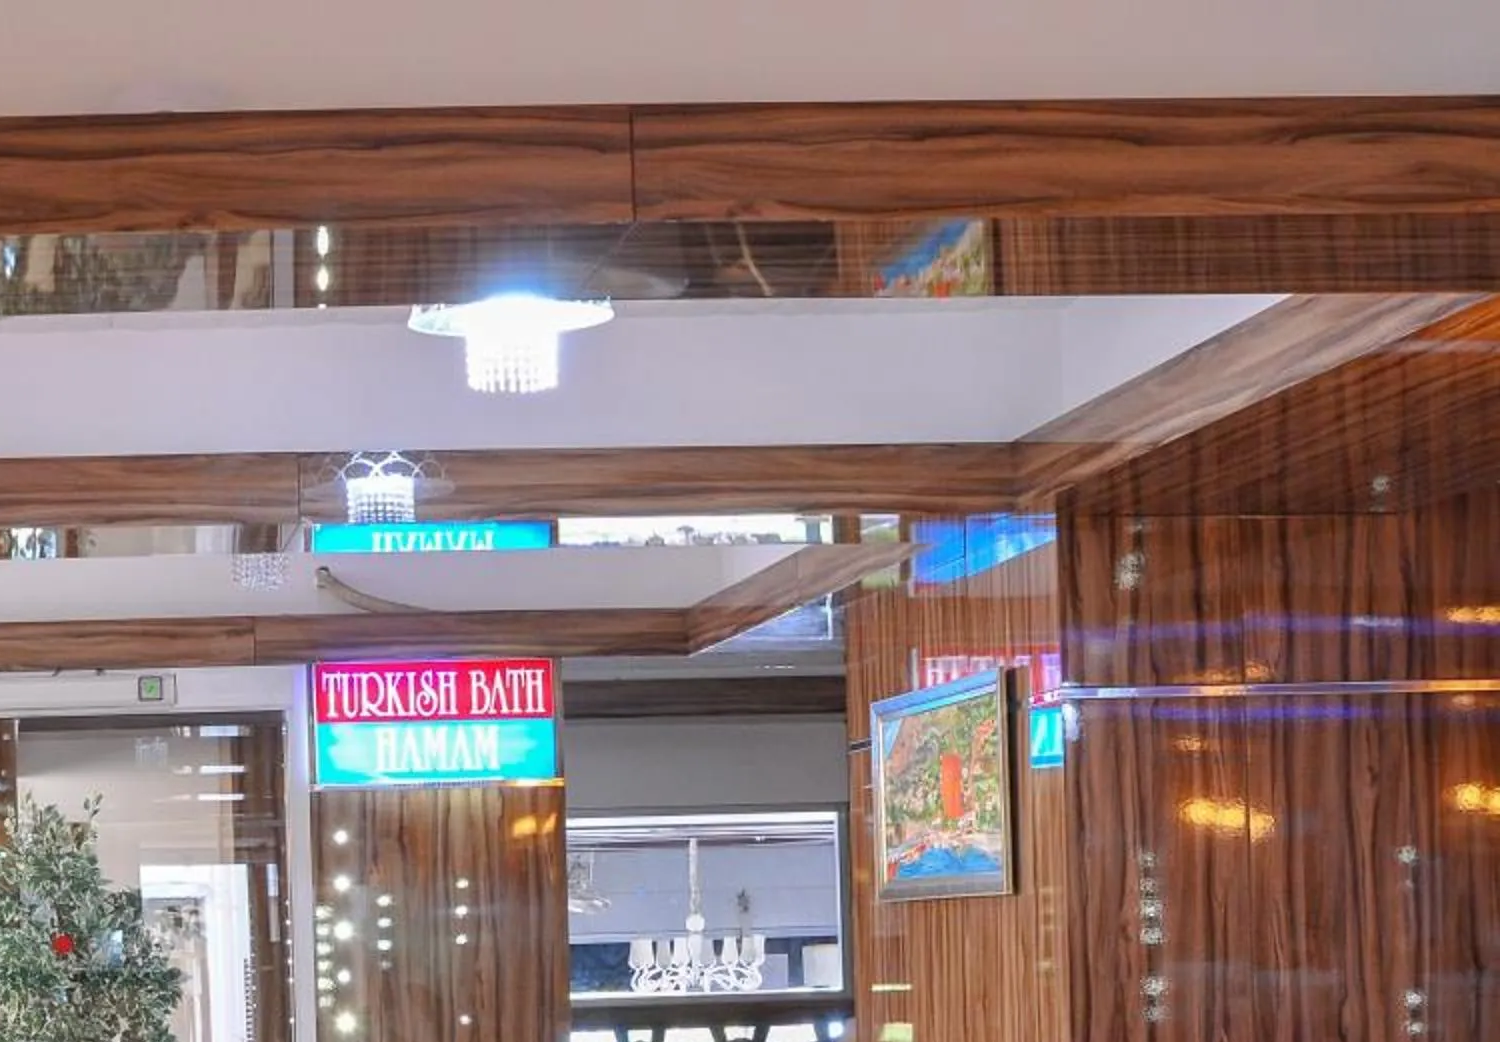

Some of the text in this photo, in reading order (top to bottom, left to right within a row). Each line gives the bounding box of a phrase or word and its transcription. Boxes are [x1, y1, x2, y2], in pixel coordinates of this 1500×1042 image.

[322, 667, 546, 718] TURKISH BATH
[375, 724, 500, 772] HAMAM
